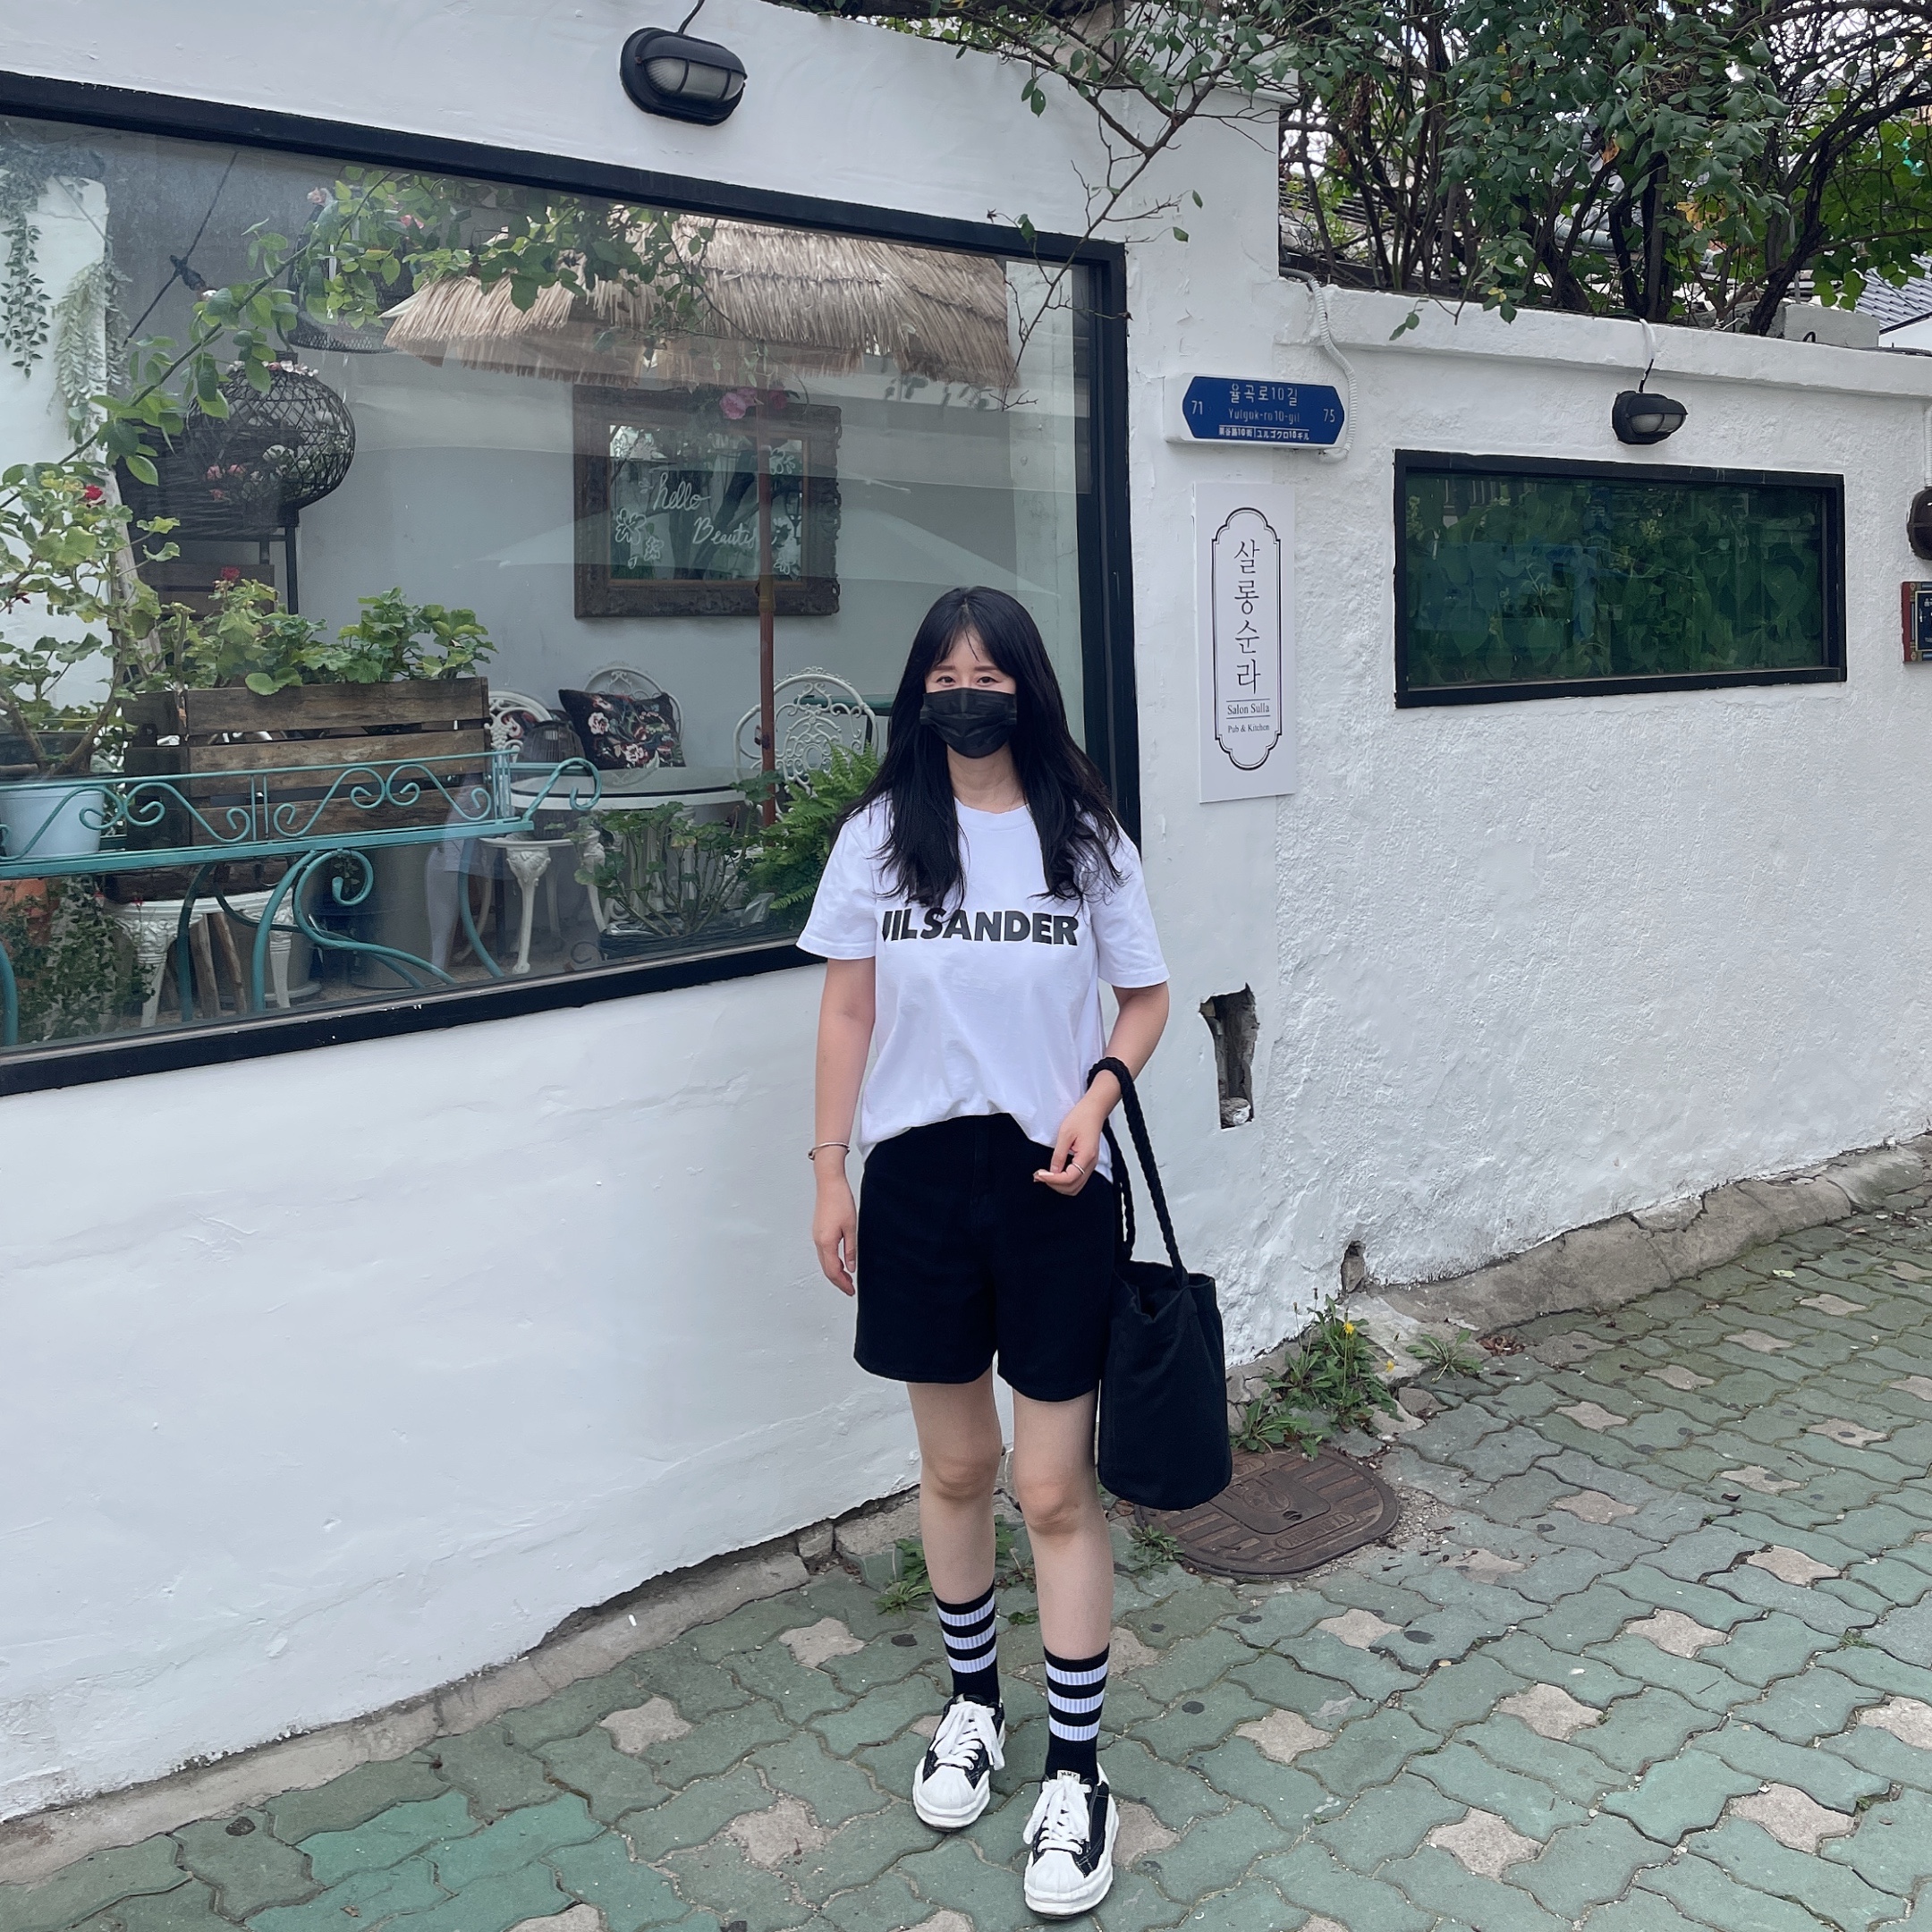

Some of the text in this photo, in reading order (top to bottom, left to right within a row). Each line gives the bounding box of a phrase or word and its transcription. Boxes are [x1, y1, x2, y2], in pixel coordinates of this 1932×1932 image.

[1229, 383, 1298, 406] 율곡로10길
[1191, 400, 1203, 415] 71
[1323, 408, 1335, 423] 75
[1228, 408, 1301, 425] Yulgok-ro 10-gil
[653, 472, 711, 511] hello
[1233, 538, 1261, 694] 살롱순라
[1227, 702, 1270, 715] Salon Sulla
[1227, 723, 1270, 733] Pub & Kitchen
